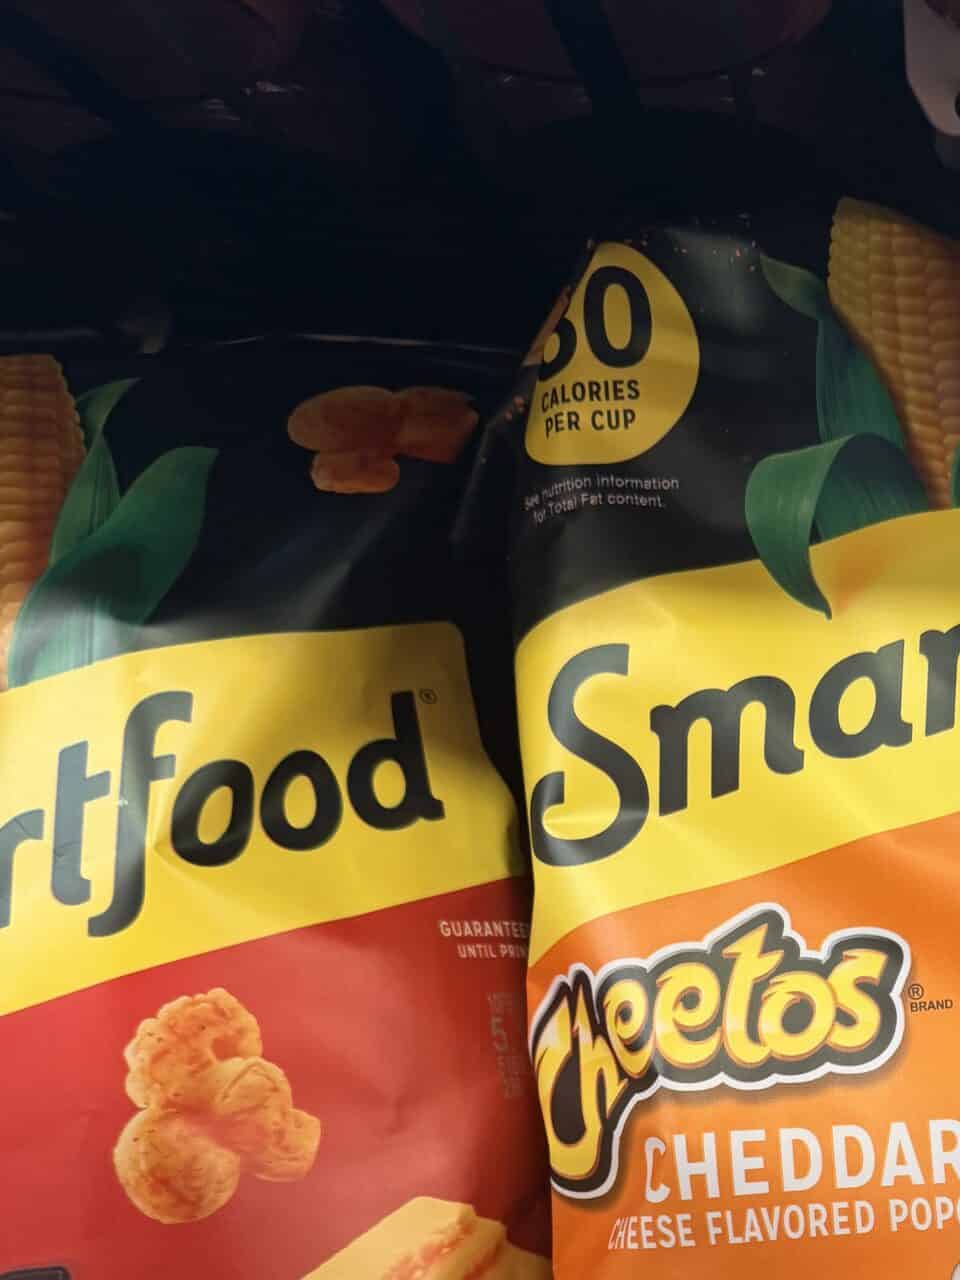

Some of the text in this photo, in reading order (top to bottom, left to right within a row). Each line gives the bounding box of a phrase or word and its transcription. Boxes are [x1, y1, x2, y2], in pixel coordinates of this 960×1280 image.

[541, 379, 641, 413] CALORIES
[545, 408, 636, 439] PER CUP
[541, 476, 592, 498] nutrition
[596, 474, 680, 490] information
[548, 495, 577, 516] Total
[581, 494, 603, 507] Fat
[457, 943, 498, 959] UNTIL
[909, 997, 954, 1013] BRAND
[532, 921, 890, 1182] Cheetos
[607, 1213, 697, 1252] CHEESE
[706, 1200, 875, 1246] FLAVORED
